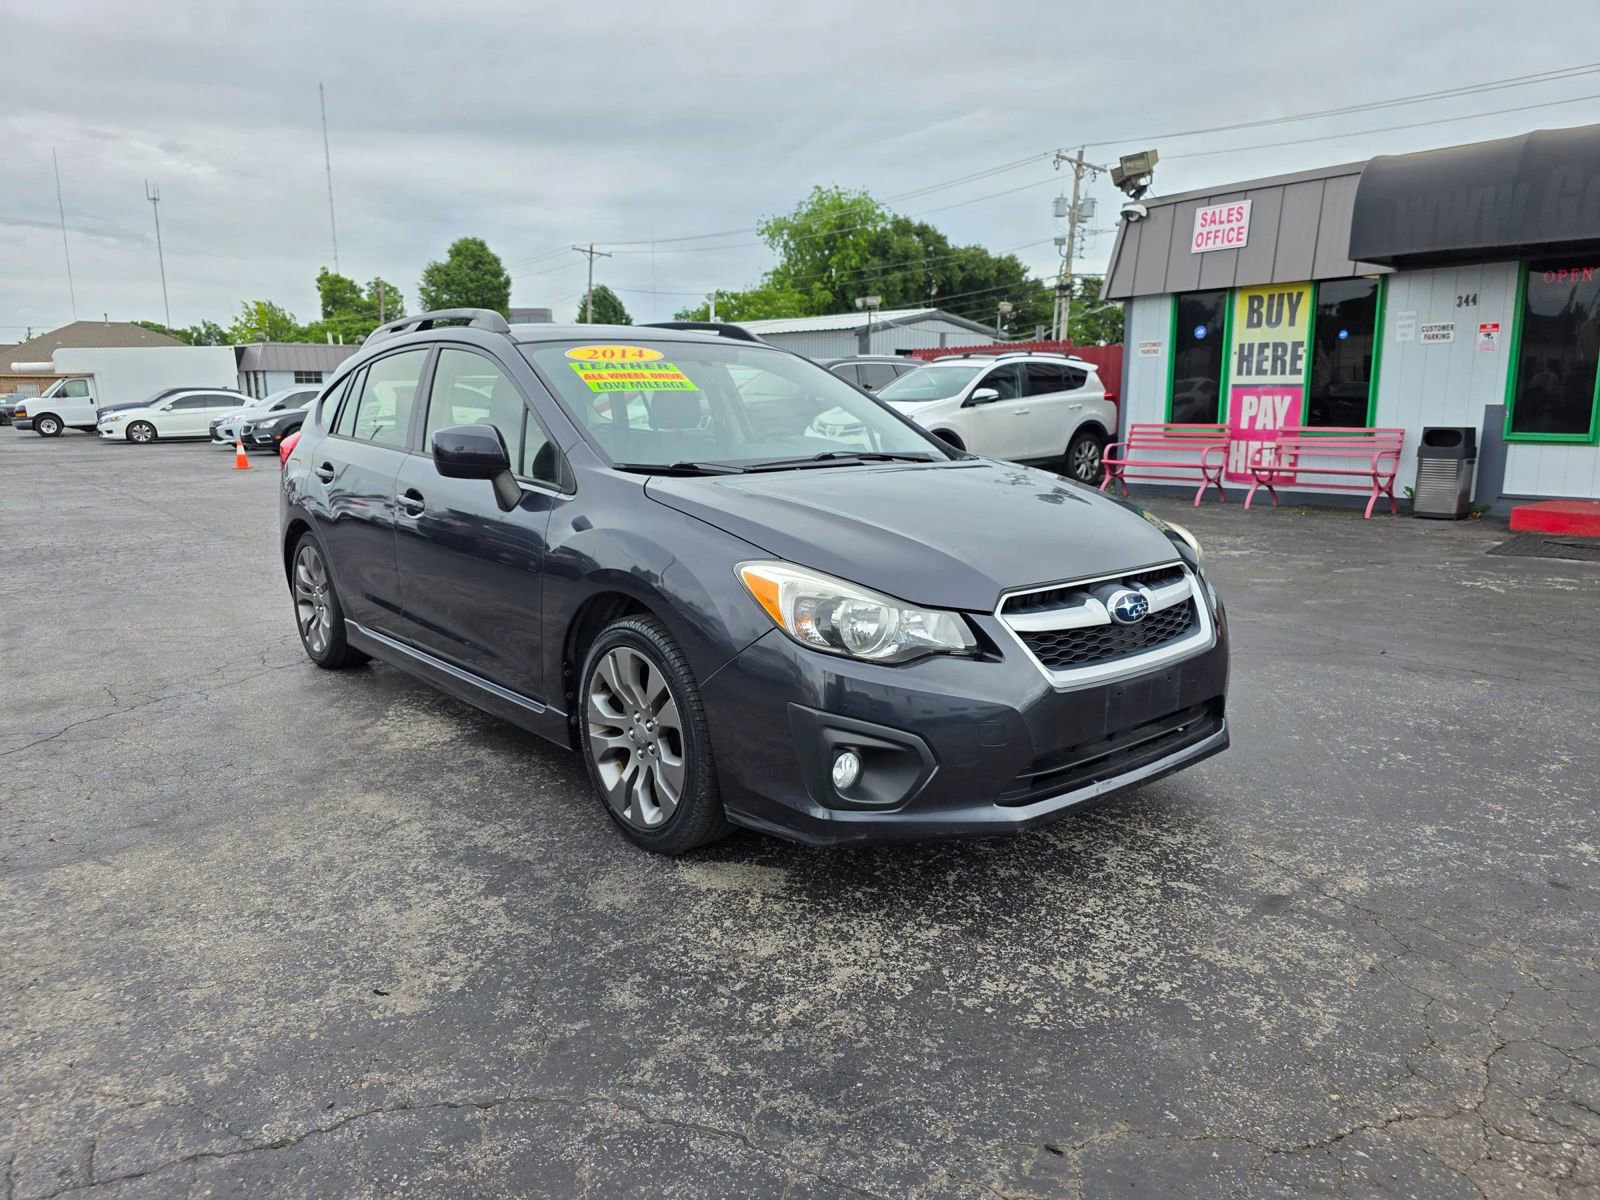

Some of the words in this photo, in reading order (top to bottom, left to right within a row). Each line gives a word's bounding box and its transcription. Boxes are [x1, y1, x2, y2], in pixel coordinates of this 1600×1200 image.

[1200, 206, 1244, 228] SALES
[1195, 226, 1245, 248] OFFICE
[1543, 266, 1594, 284] OPEN
[1456, 294, 1478, 308] 344
[1246, 292, 1304, 329] BUY
[1421, 323, 1454, 333] CUSTOMER
[1424, 332, 1451, 341] PARKING
[587, 349, 644, 359] 2014
[1236, 341, 1305, 376] HERE
[578, 362, 669, 370] LEATHER
[631, 381, 687, 389] MILEAGE
[1241, 395, 1292, 430] PAY
